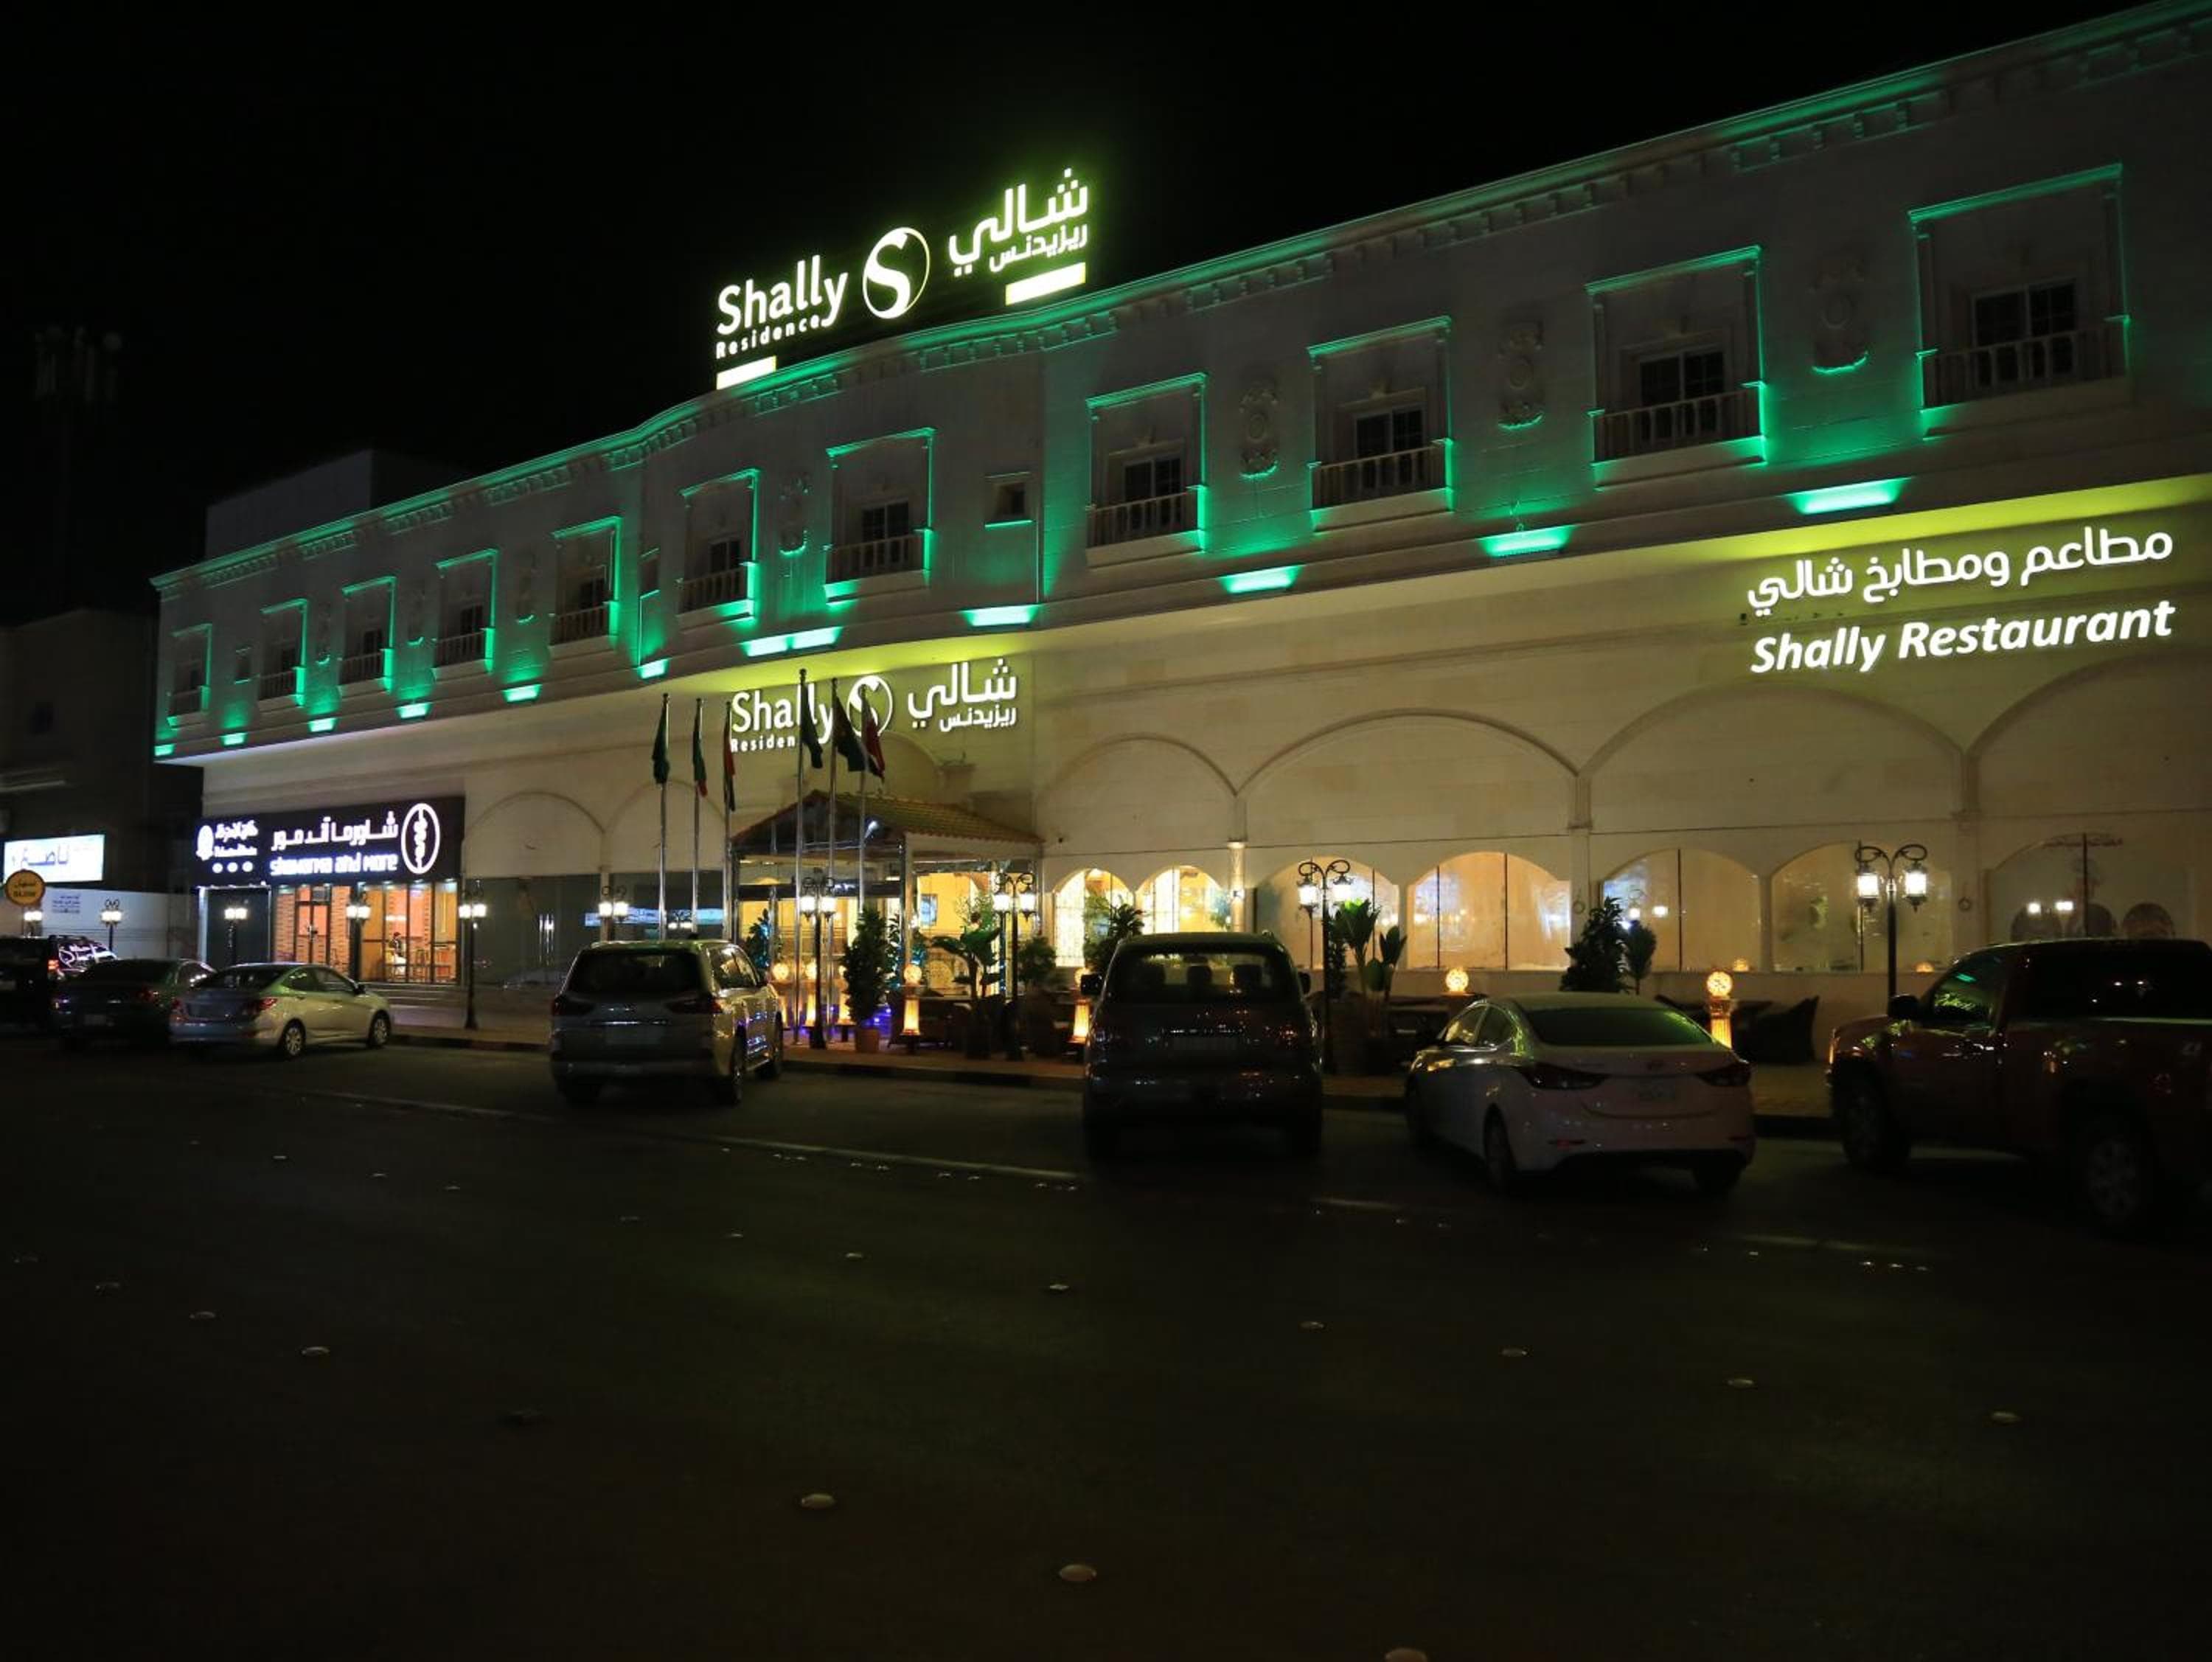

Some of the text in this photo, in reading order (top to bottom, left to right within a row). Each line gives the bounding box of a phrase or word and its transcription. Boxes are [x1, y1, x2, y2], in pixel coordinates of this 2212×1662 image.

[948, 167, 1088, 277] شالي
[989, 223, 1088, 273] ريزيدنس
[717, 254, 849, 335] Shally
[716, 314, 820, 359] Residence
[1747, 526, 2173, 617] مطاعم ومطابخ شالي
[1750, 600, 2176, 673] Shally Restaurant
[731, 682, 833, 745] Shally
[908, 658, 1017, 729] شالي
[939, 704, 1017, 732] ريزيدنس
[729, 734, 796, 752] Residen
